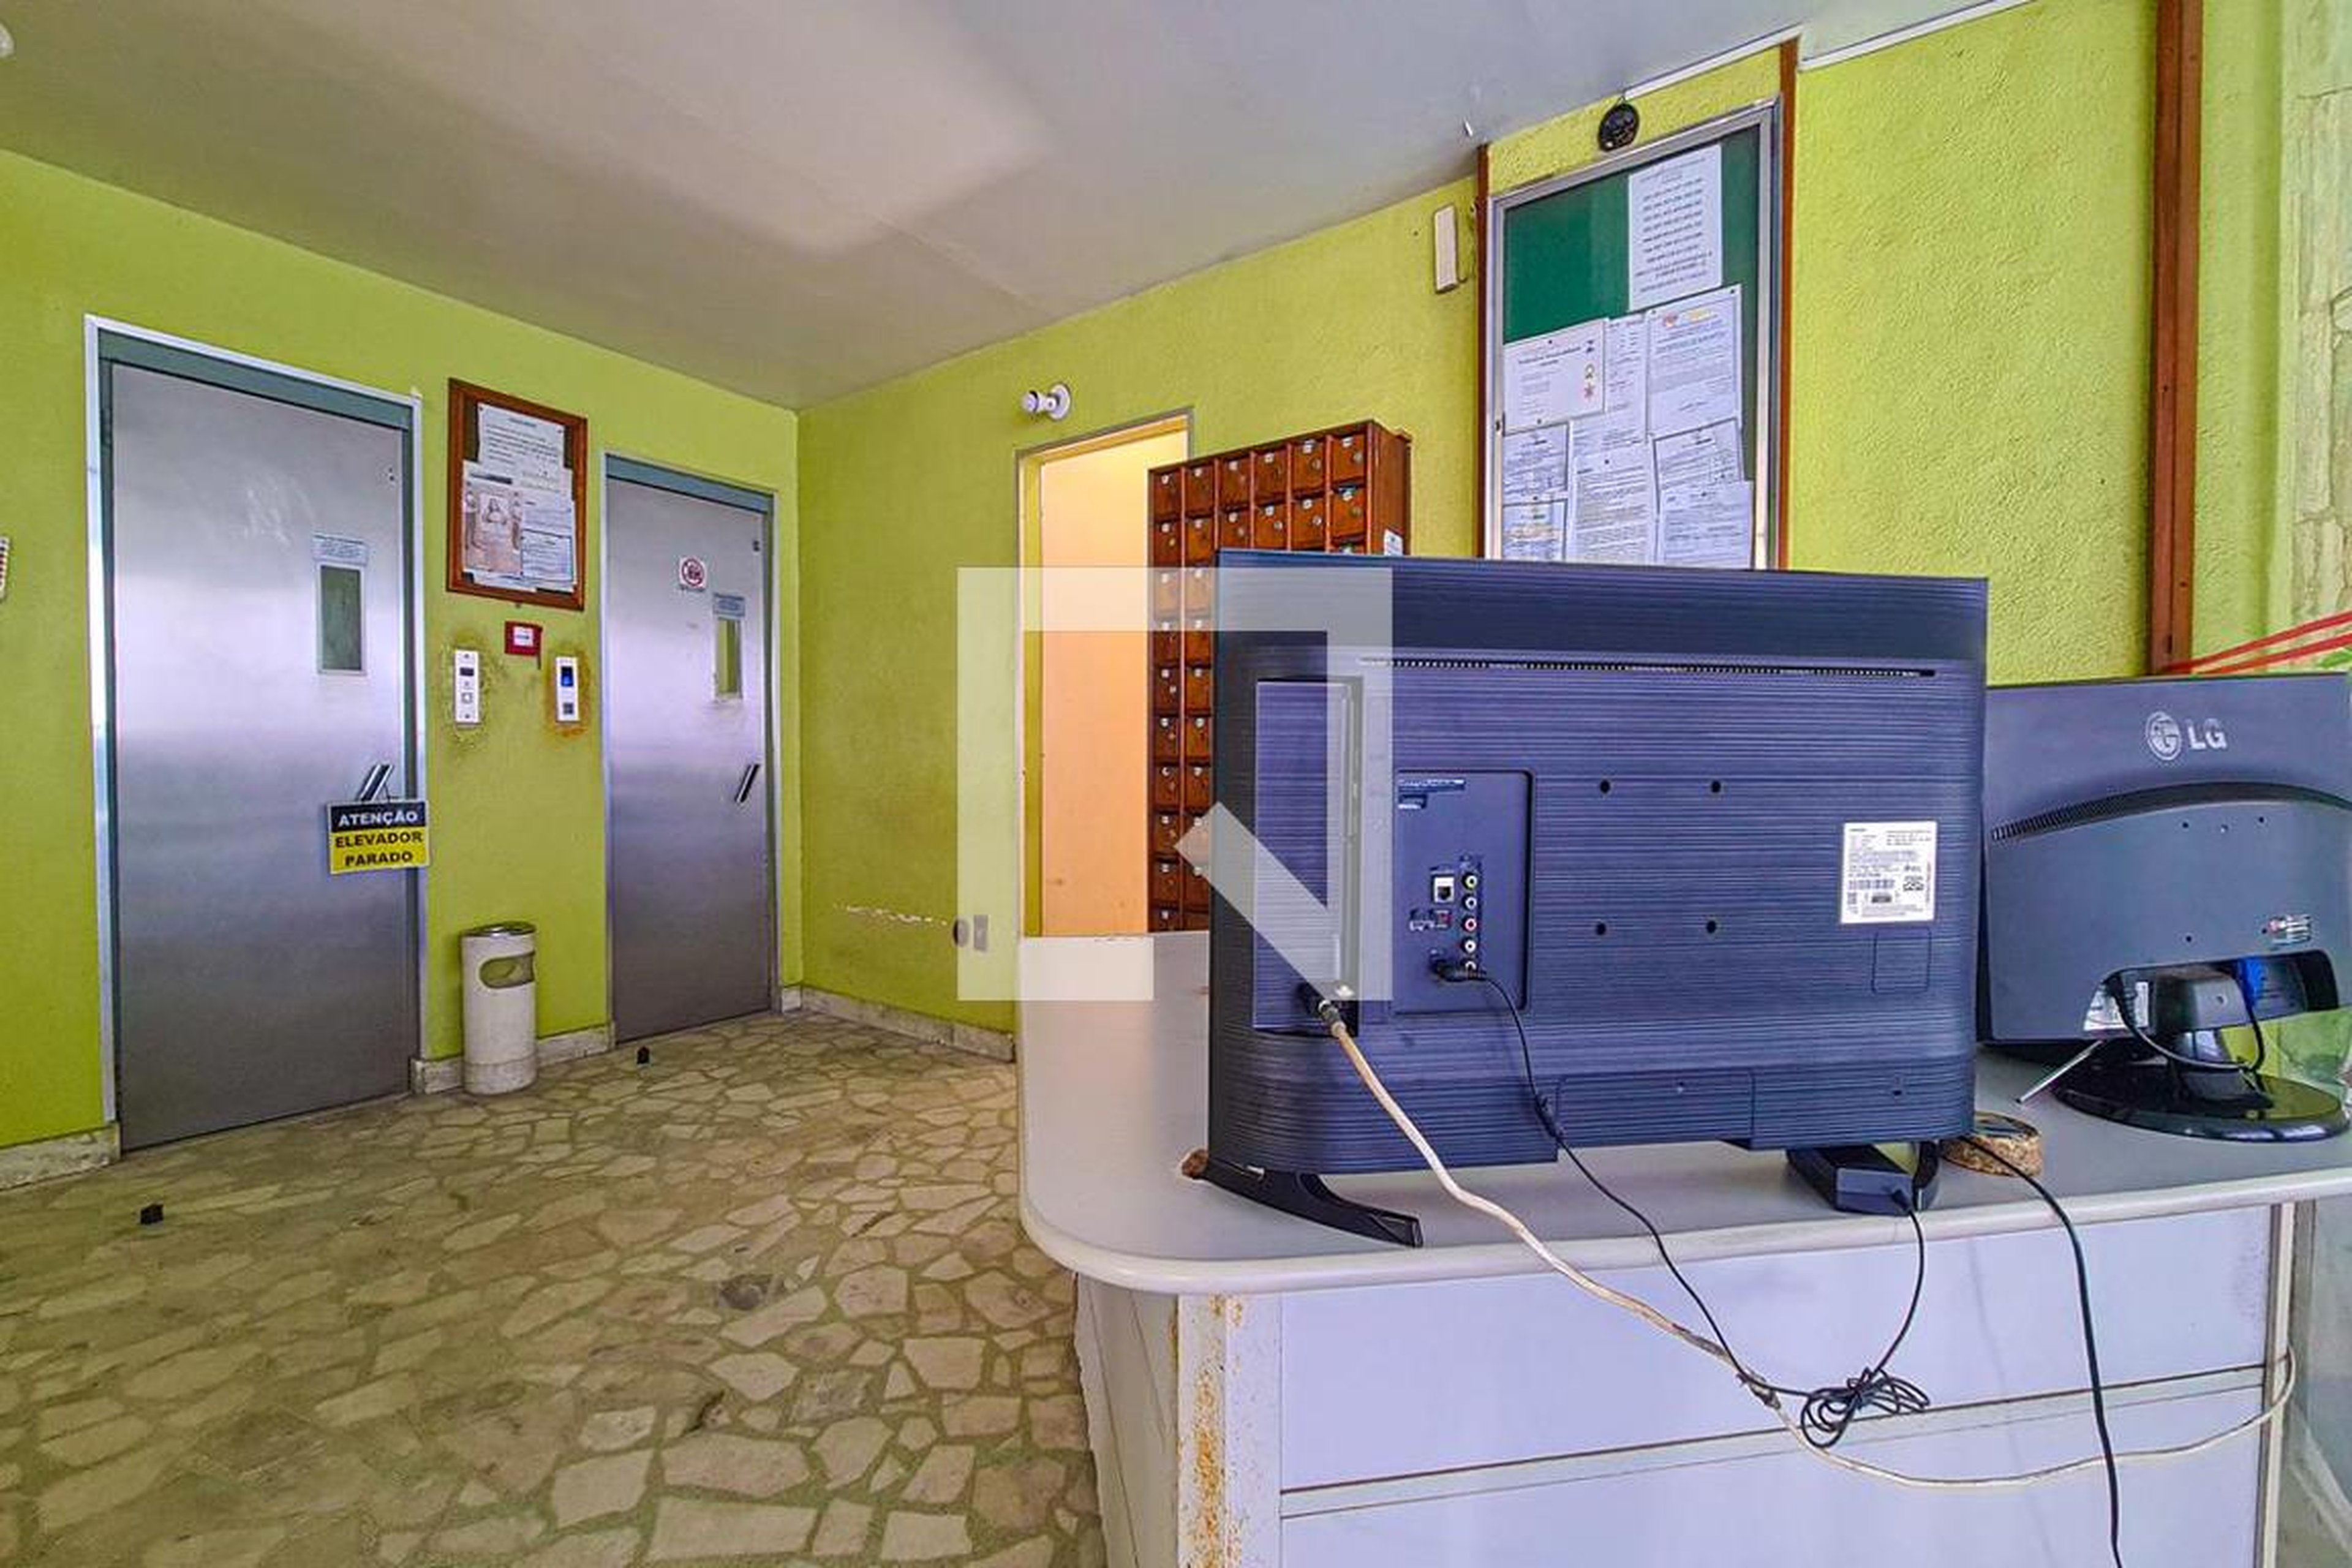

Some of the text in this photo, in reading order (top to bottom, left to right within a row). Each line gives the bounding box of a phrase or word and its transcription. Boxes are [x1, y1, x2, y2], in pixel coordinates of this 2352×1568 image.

[2185, 718, 2228, 750] LG
[338, 810, 418, 827] ATENÇÃO
[335, 831, 424, 848] ELEVADOR
[345, 851, 413, 866] PARADO
